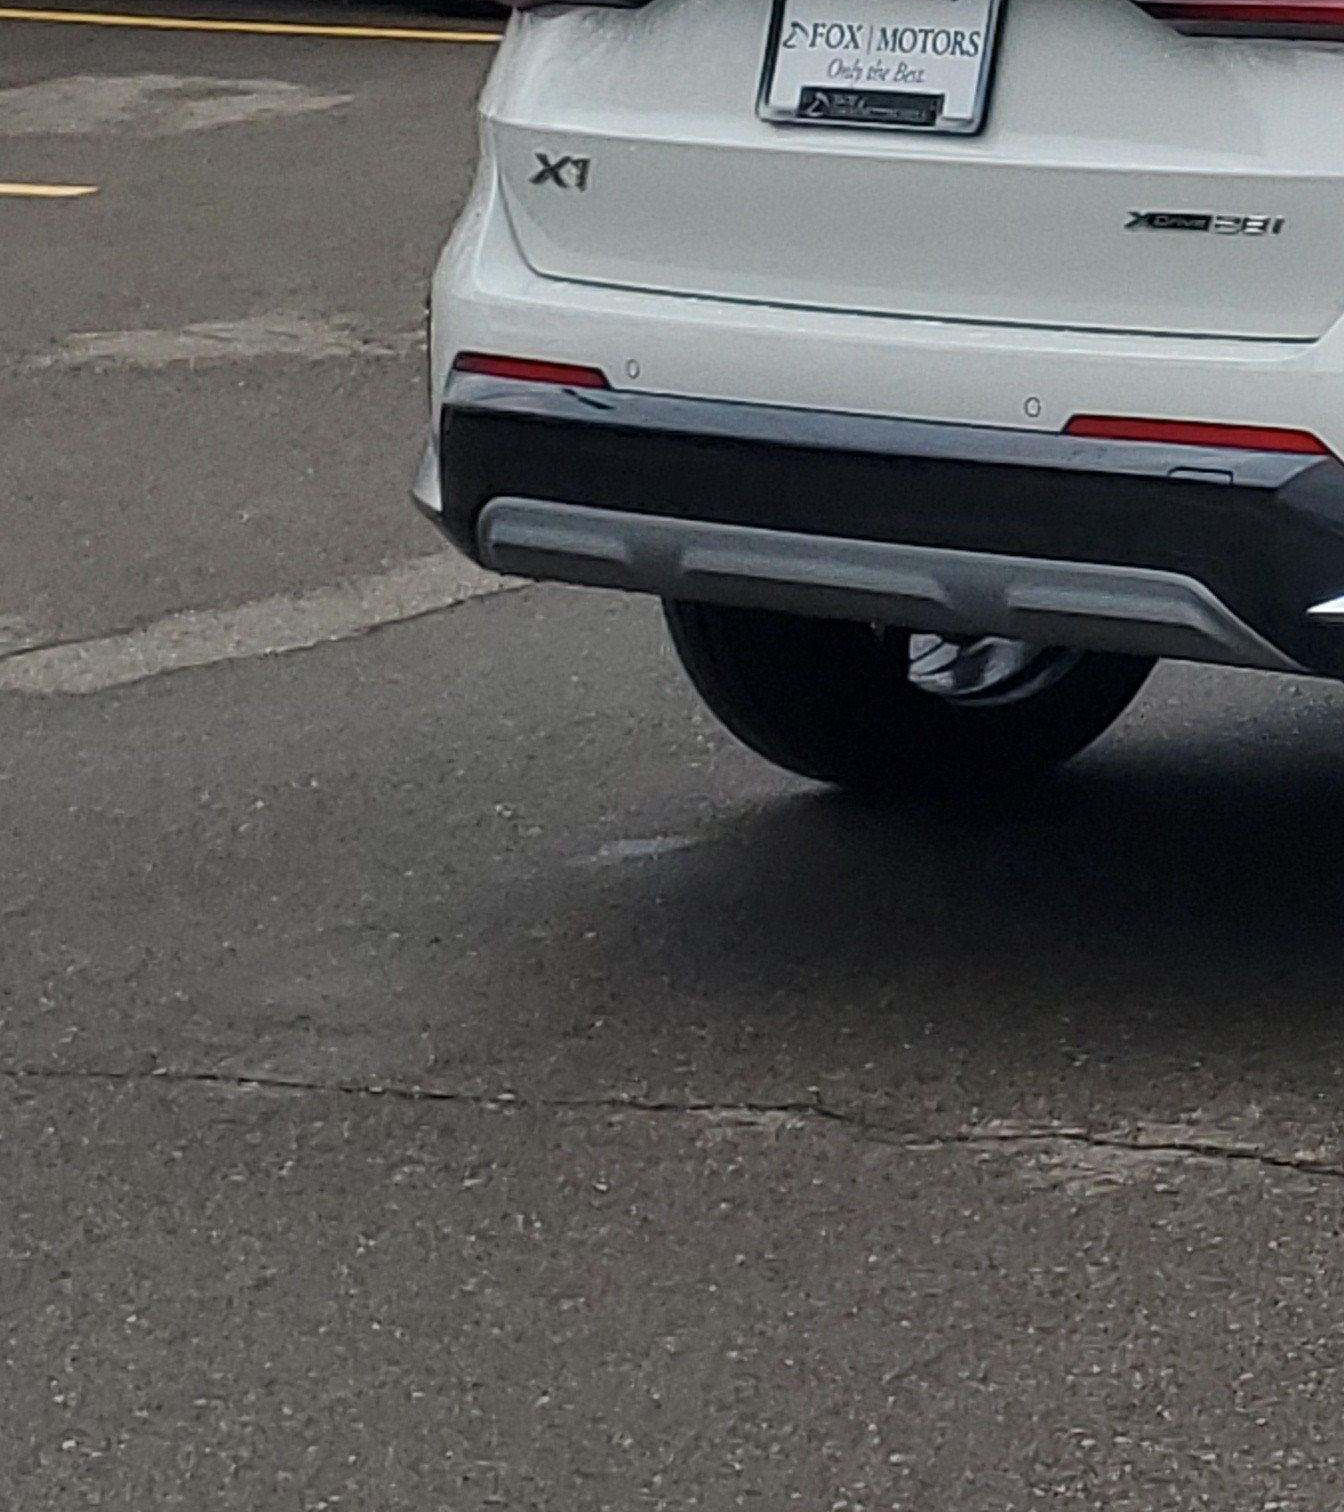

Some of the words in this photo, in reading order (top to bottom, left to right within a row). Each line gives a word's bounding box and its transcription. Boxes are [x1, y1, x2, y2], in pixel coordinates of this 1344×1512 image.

[809, 23, 864, 51] FOX
[876, 27, 981, 58] MOTORS
[527, 152, 591, 192] X1
